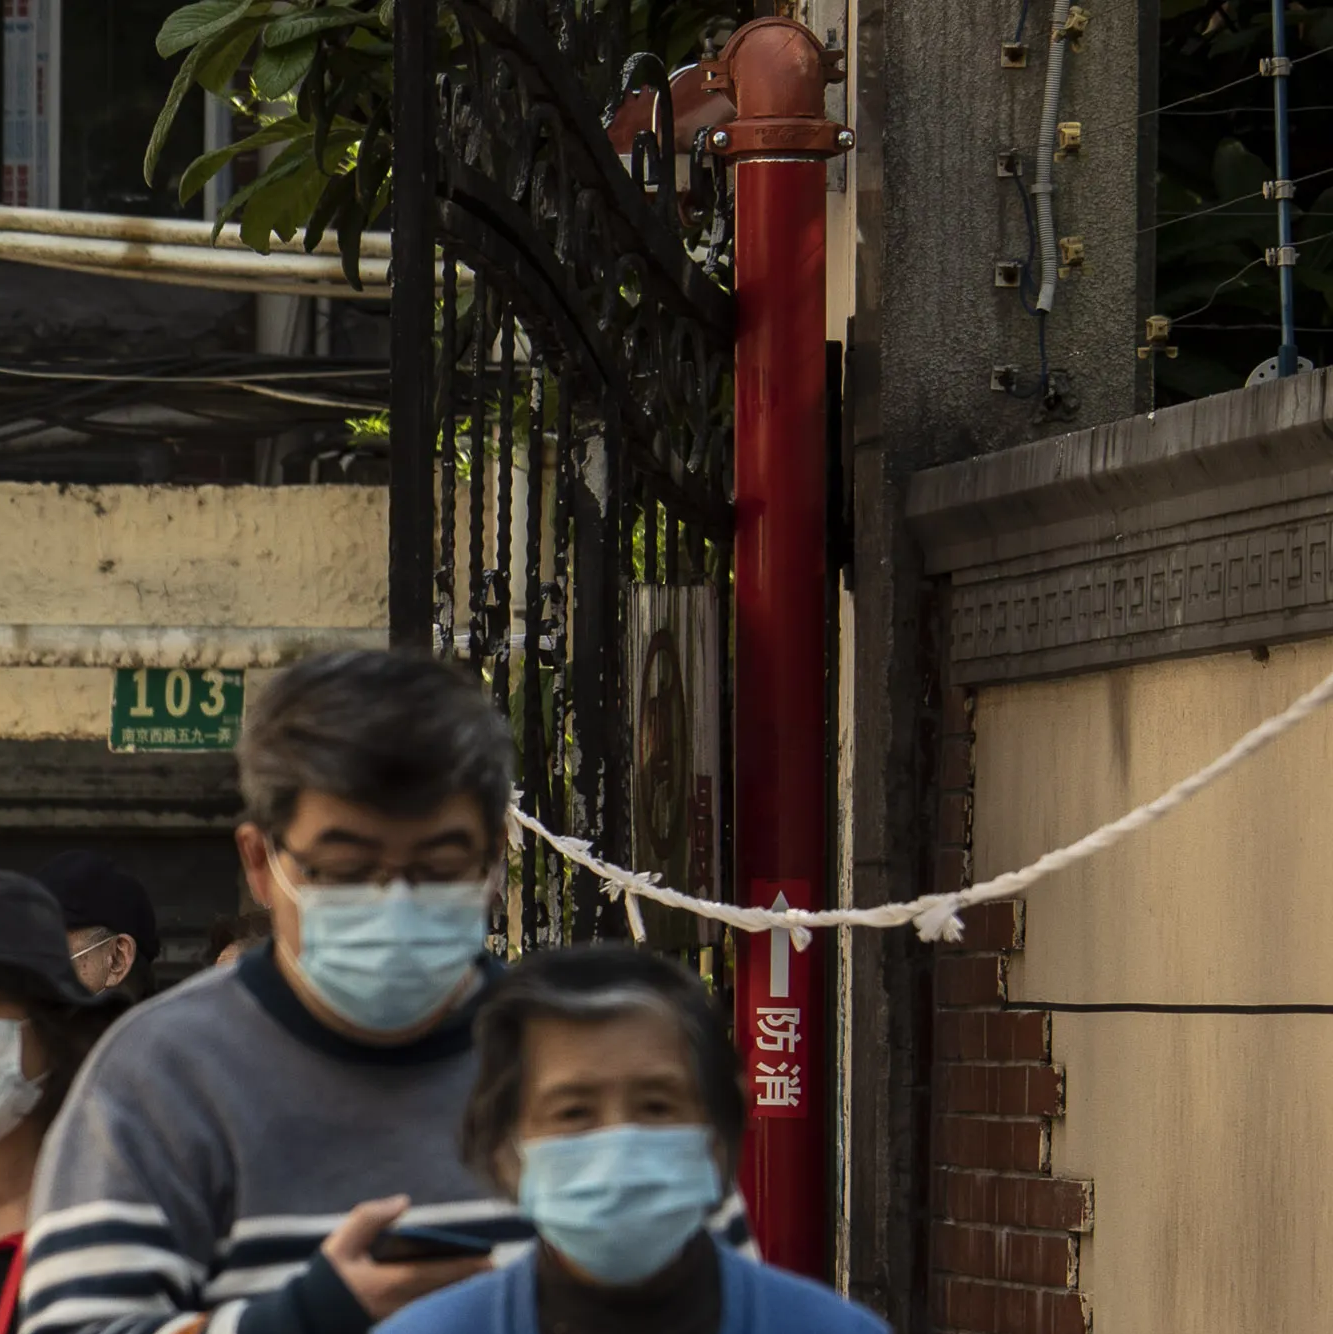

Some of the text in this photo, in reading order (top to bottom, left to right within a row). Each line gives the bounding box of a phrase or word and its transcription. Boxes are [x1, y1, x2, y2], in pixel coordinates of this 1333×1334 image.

[129, 669, 226, 718] 103
[121, 726, 232, 744] 南京西路五九一弄
